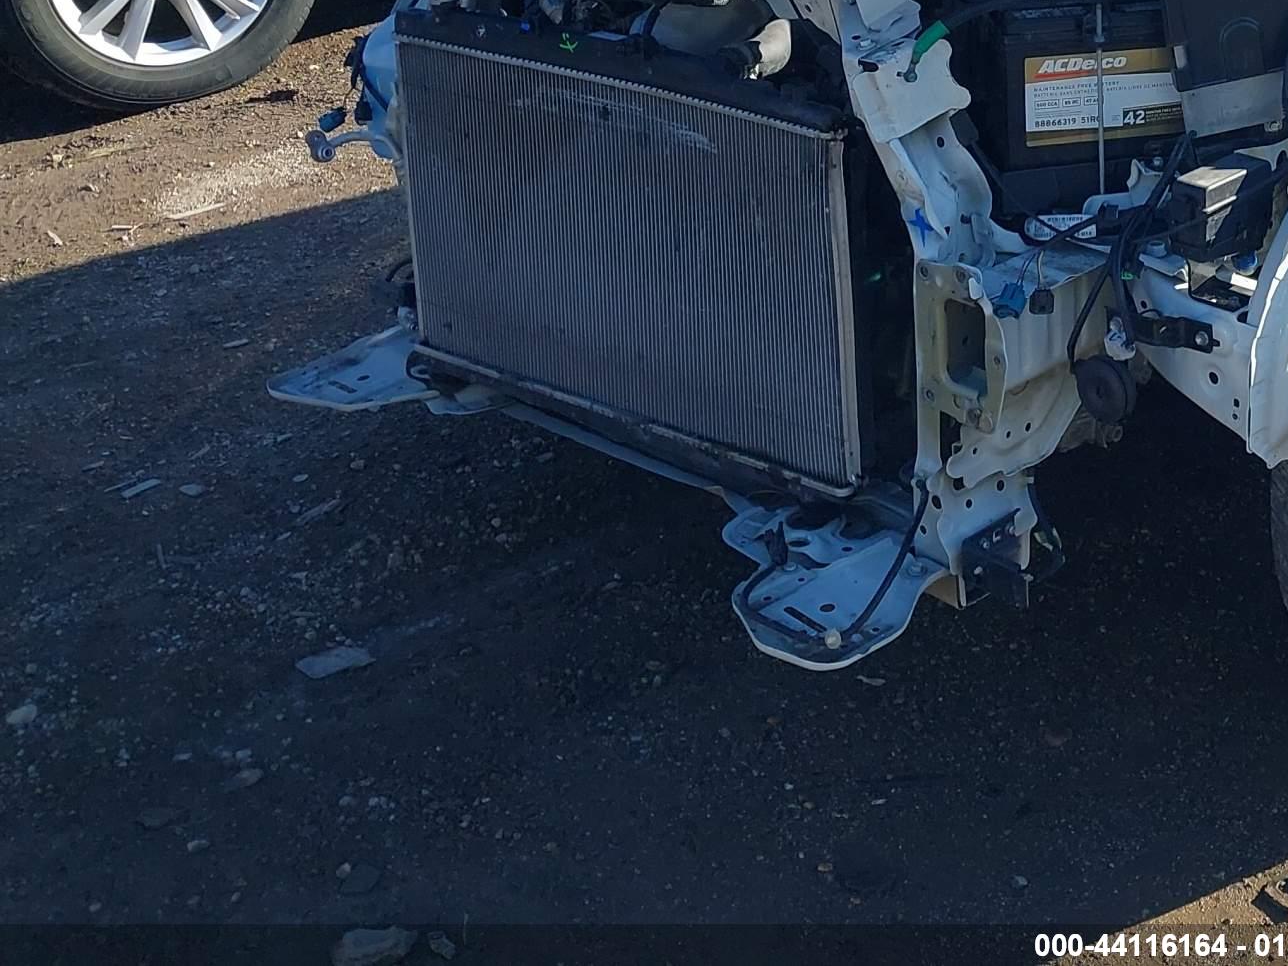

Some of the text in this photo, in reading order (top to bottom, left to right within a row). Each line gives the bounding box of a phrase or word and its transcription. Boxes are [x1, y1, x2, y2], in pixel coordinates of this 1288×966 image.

[1037, 56, 1128, 75] ACDeco
[1034, 117, 1077, 128] 88866319
[1123, 110, 1146, 125] 42
